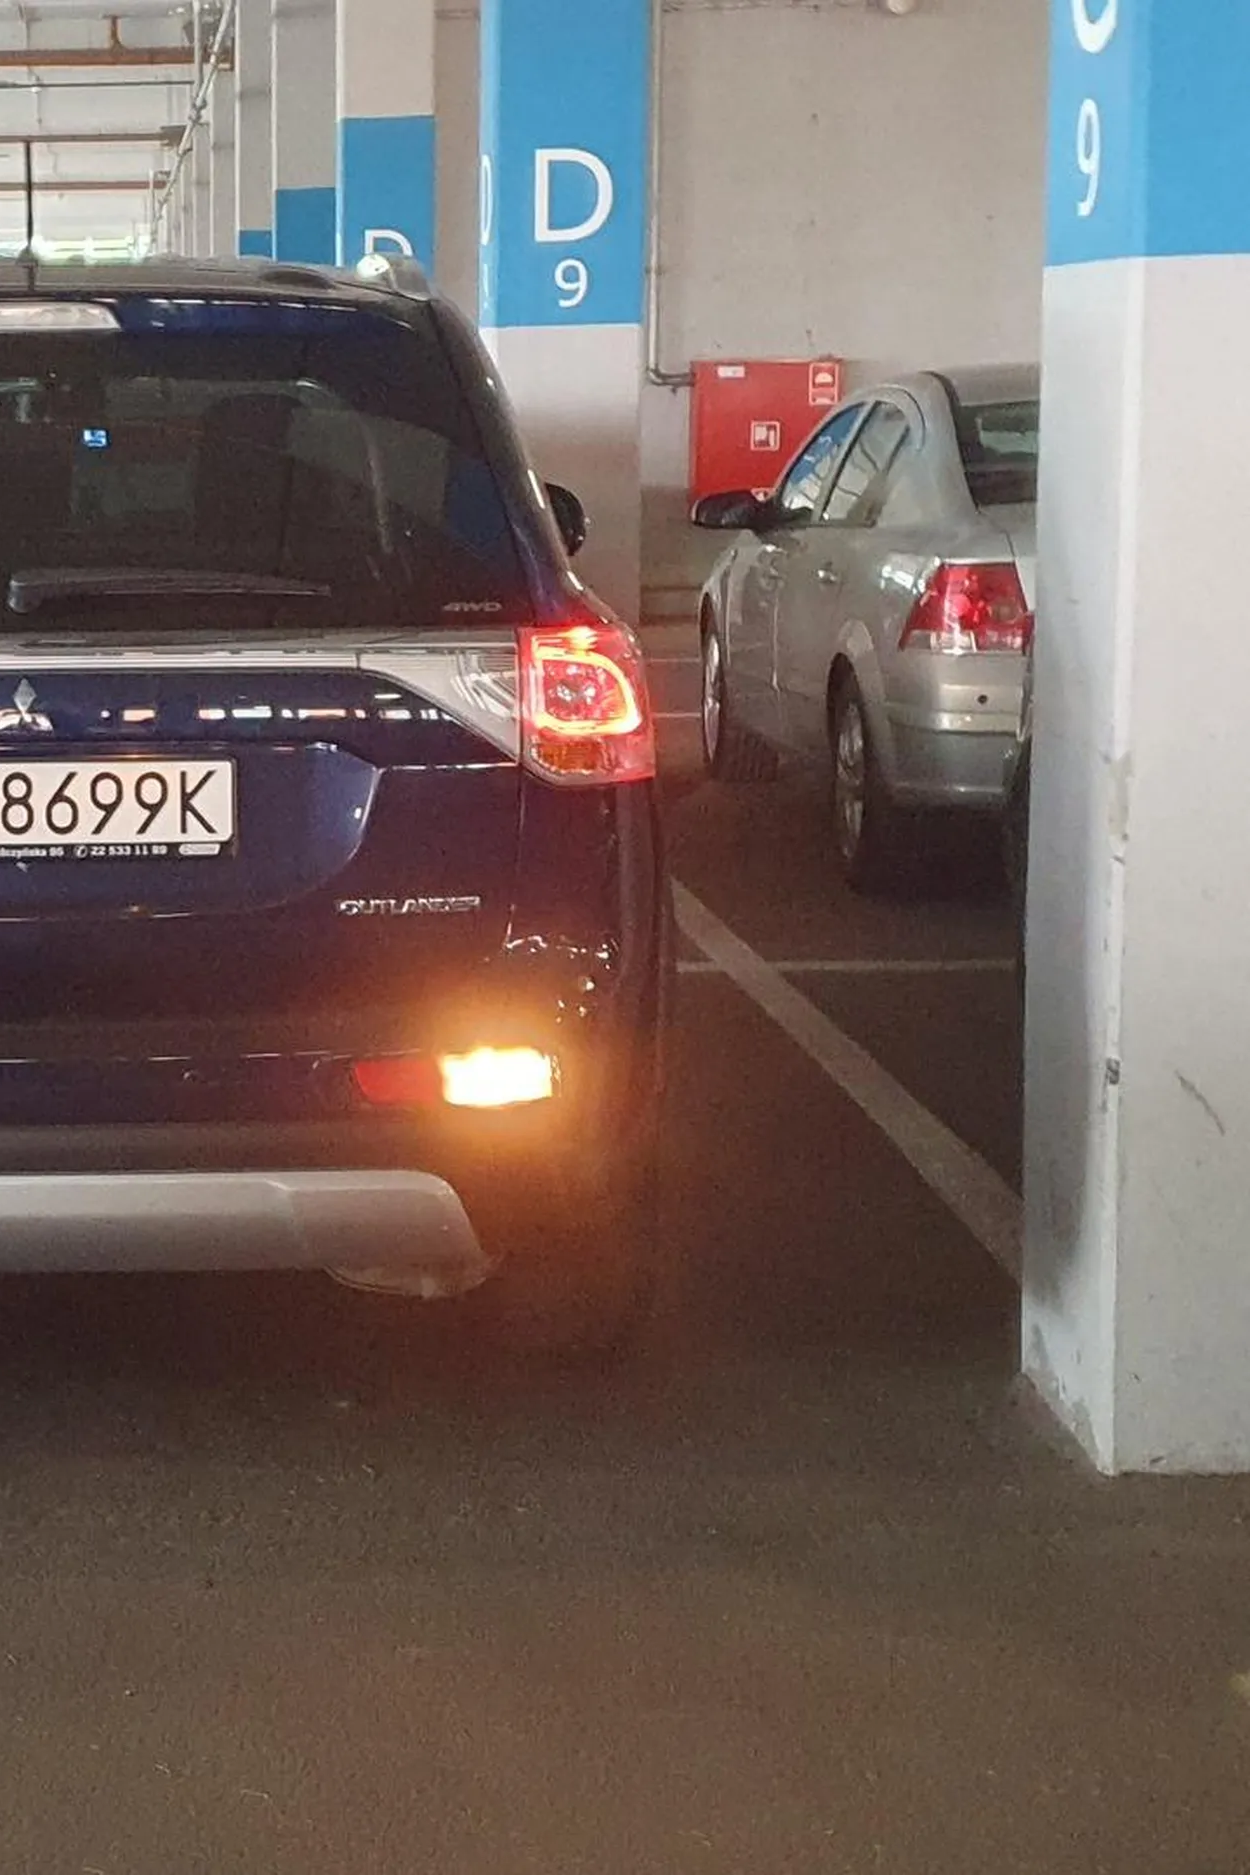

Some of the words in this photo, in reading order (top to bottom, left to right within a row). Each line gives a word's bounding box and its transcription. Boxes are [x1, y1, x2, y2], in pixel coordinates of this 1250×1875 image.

[1076, 99, 1100, 217] 9
[534, 148, 614, 243] D
[554, 257, 589, 308] 9
[443, 602, 502, 612] 4WD
[0, 769, 218, 836] 8699K
